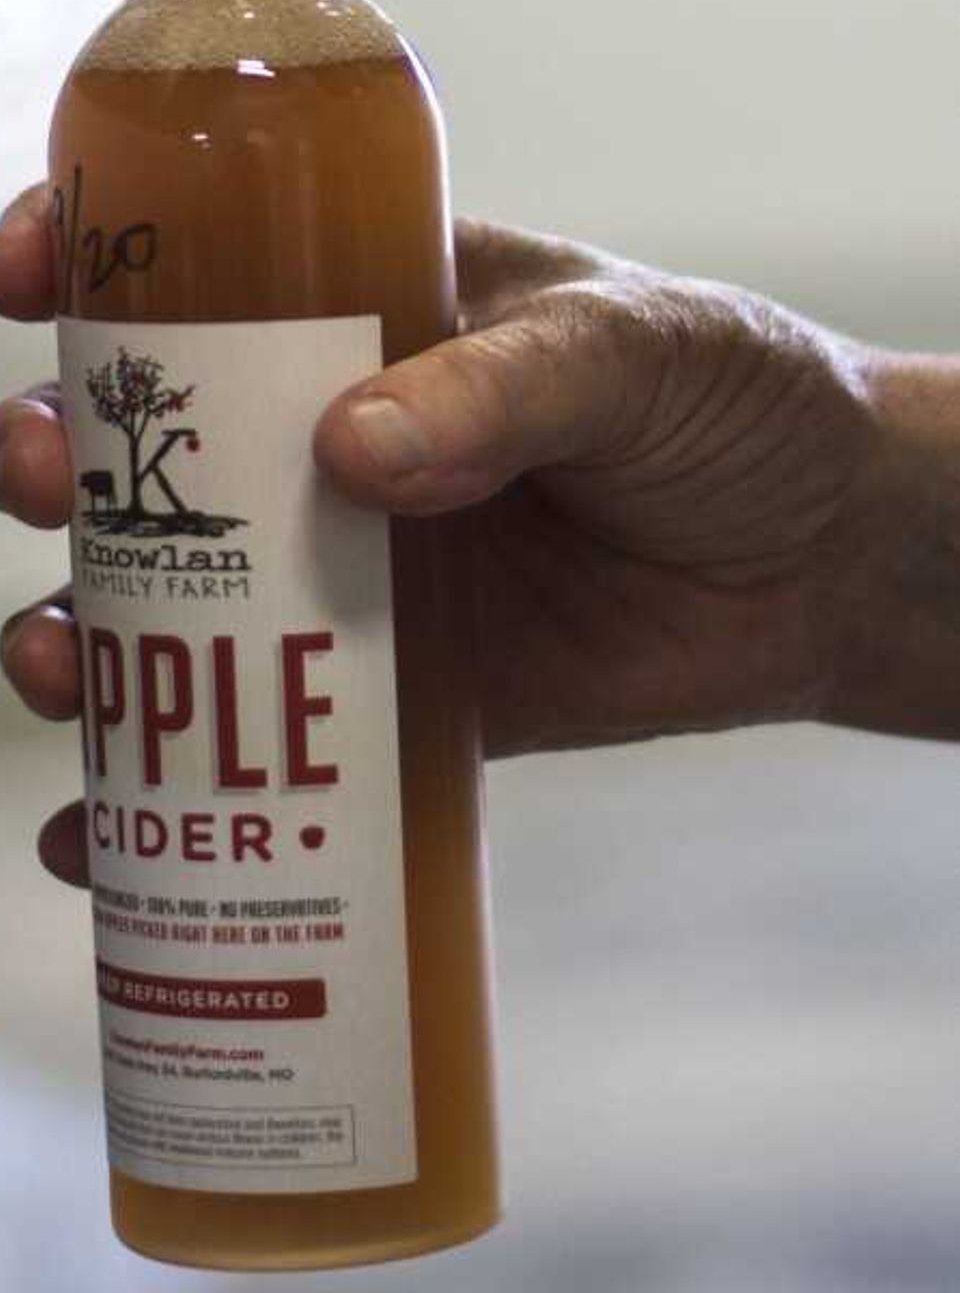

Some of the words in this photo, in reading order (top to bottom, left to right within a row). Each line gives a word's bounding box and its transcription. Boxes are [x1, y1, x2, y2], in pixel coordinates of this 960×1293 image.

[80, 538, 252, 573] Knowlan
[82, 569, 153, 599] FAMILY
[165, 576, 251, 600] FARM
[83, 627, 339, 790] PPLE
[94, 800, 274, 862] CIDER
[251, 926, 270, 943] ON
[276, 925, 299, 942] THE
[123, 981, 290, 1010] REFRIGERATED
